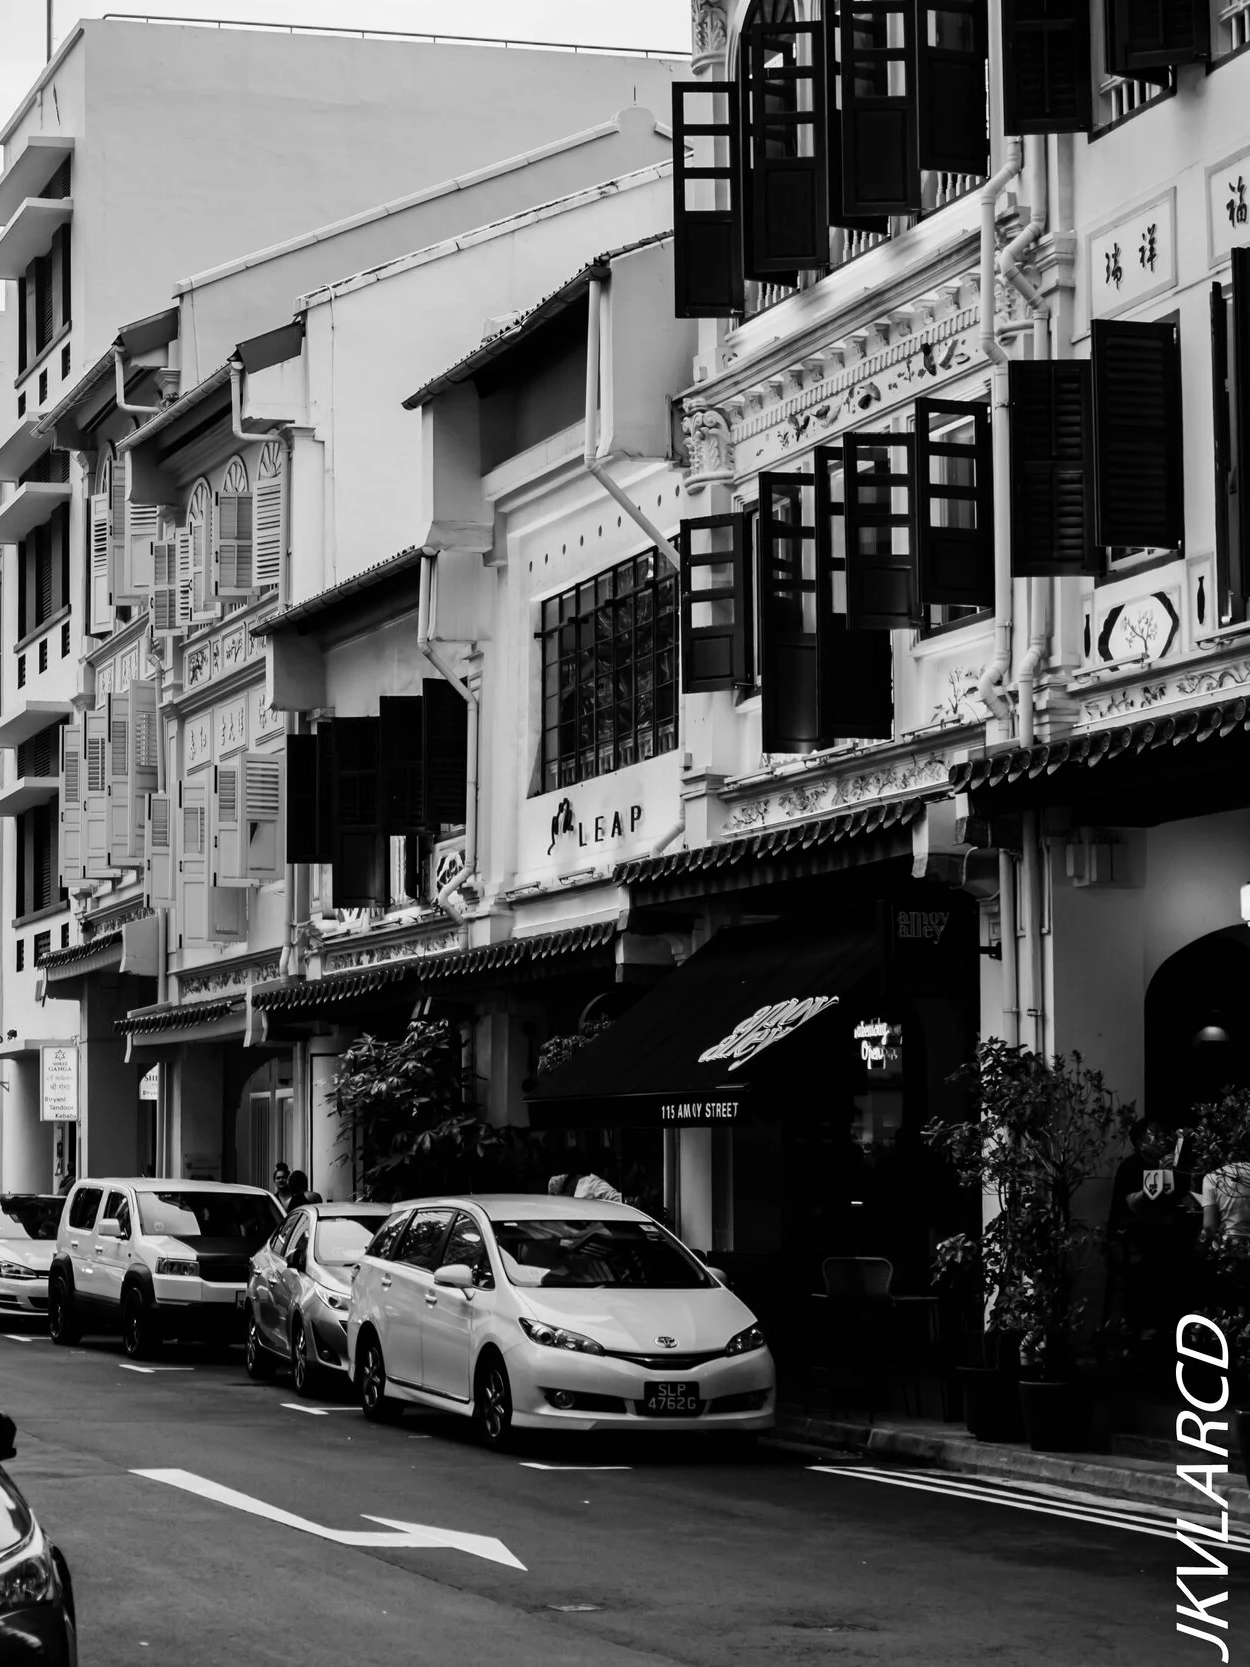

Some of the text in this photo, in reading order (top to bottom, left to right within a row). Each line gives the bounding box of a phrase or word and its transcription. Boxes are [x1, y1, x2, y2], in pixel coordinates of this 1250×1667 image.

[579, 805, 642, 847] LEAP
[662, 1102, 739, 1119] 115 AMOY STREET
[658, 1384, 686, 1397] SLP
[648, 1397, 696, 1410] 4762G
